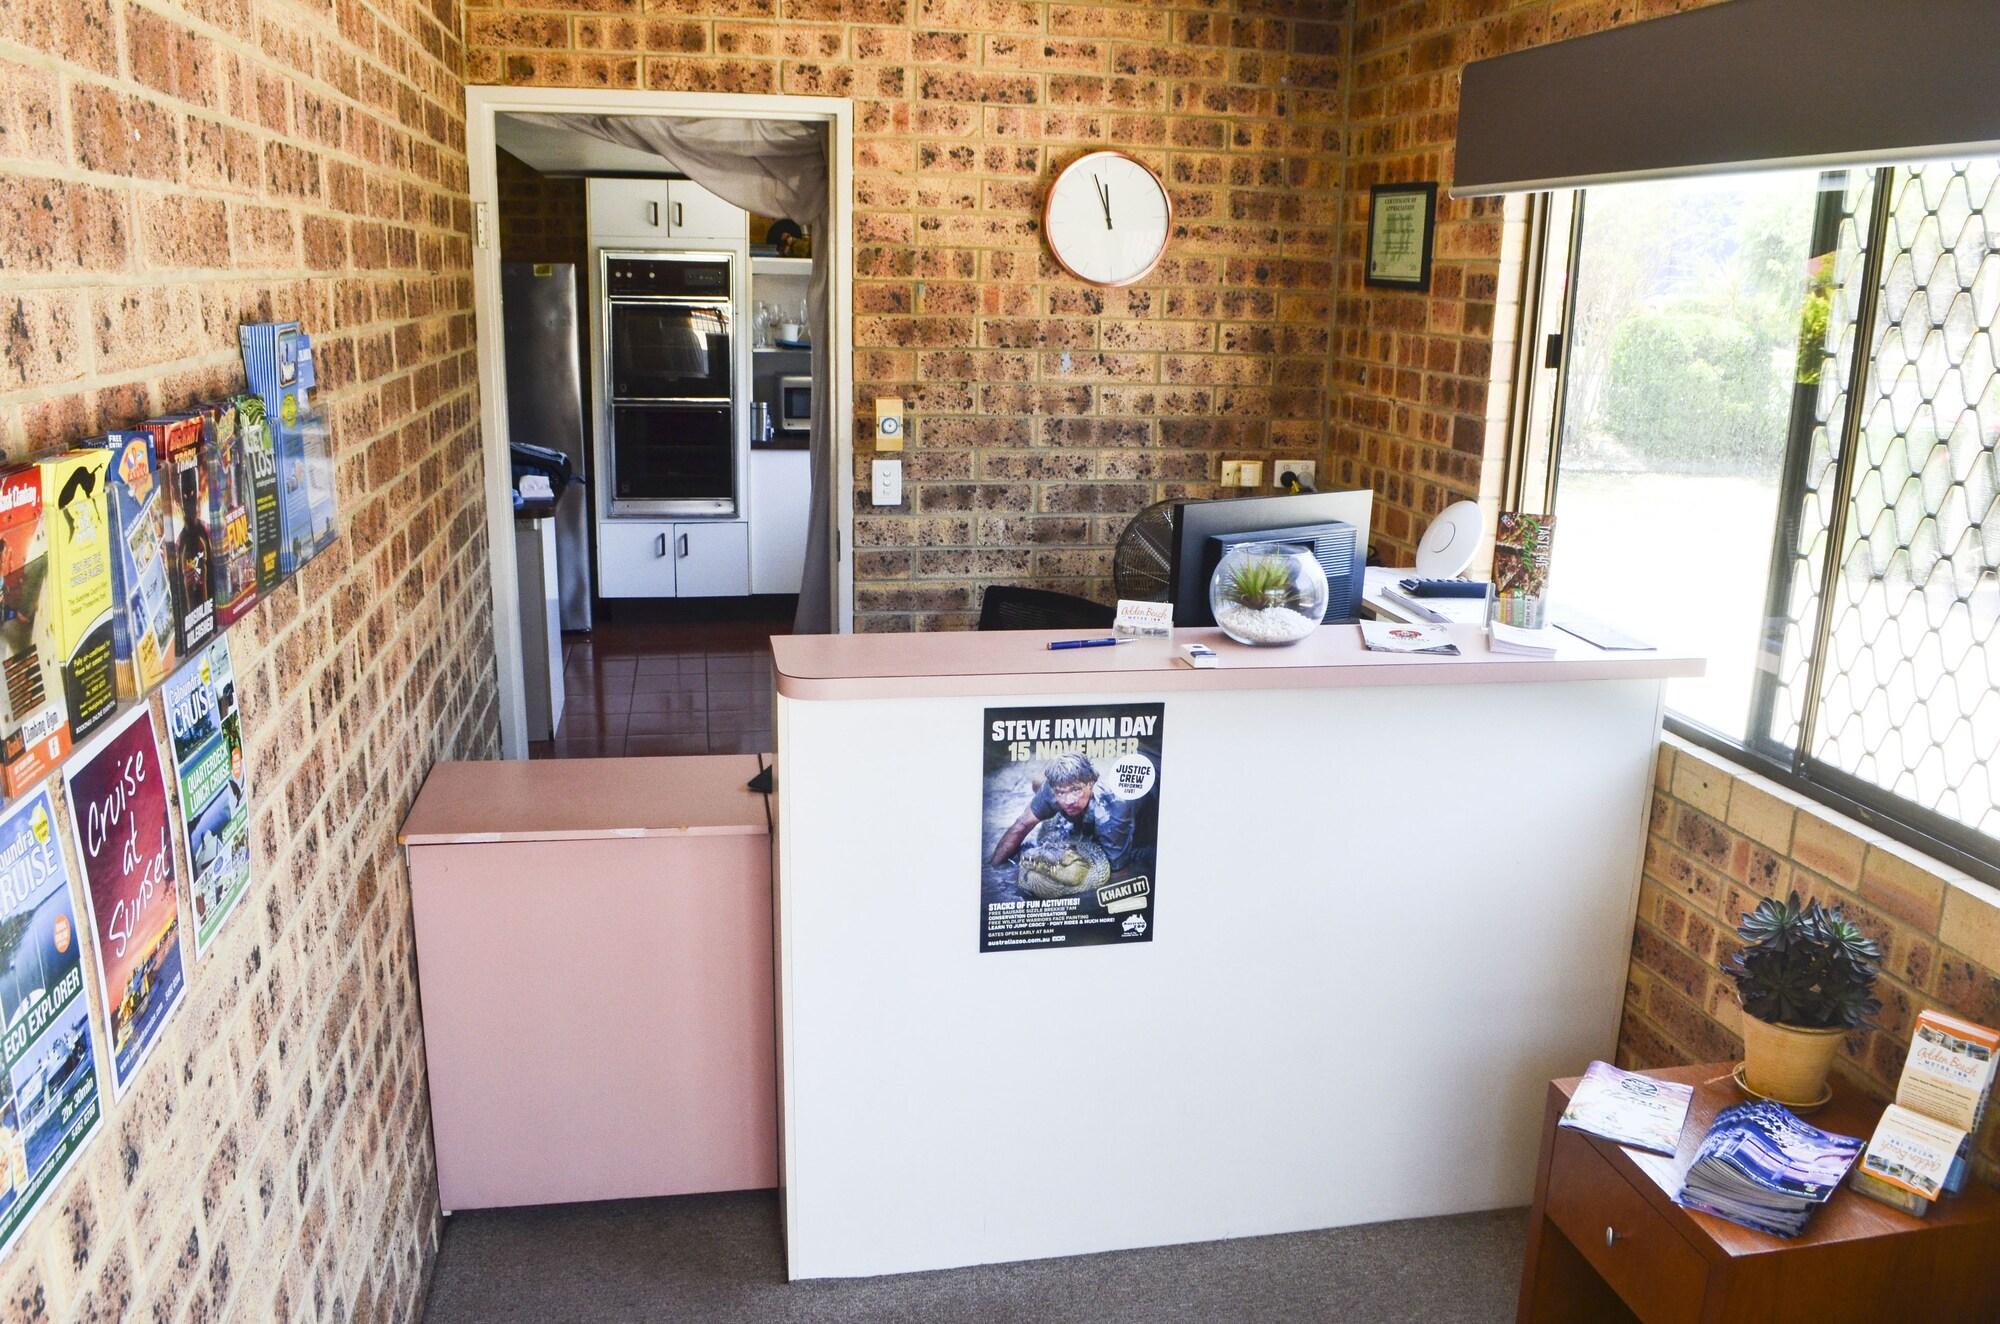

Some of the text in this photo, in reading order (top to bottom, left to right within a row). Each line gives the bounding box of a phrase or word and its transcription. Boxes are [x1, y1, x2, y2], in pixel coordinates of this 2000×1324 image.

[252, 448, 276, 479] LOST
[1146, 607, 1168, 618] Beach
[173, 685, 216, 738] CRUISE
[992, 715, 1158, 742] STEVE IRWIN DAY
[1008, 738, 1139, 762] 15 NOVEMBER
[187, 740, 228, 794] QUARTERDECK
[1116, 764, 1151, 775] JUSTICE
[1120, 774, 1144, 784] CREW
[190, 760, 230, 814] LUNCH CRUISE
[88, 750, 146, 858] Cruise
[123, 810, 142, 876] at
[108, 826, 170, 959] Sunset
[988, 898, 1080, 911] STACKS OF FUN ACTIVITIES!
[1100, 880, 1146, 902] KHAKI IT!
[988, 937, 1050, 946] australiazoo.com.au
[3, 966, 81, 1064] ECO EXPLORER
[1916, 1046, 1978, 1078] Golden Beach
